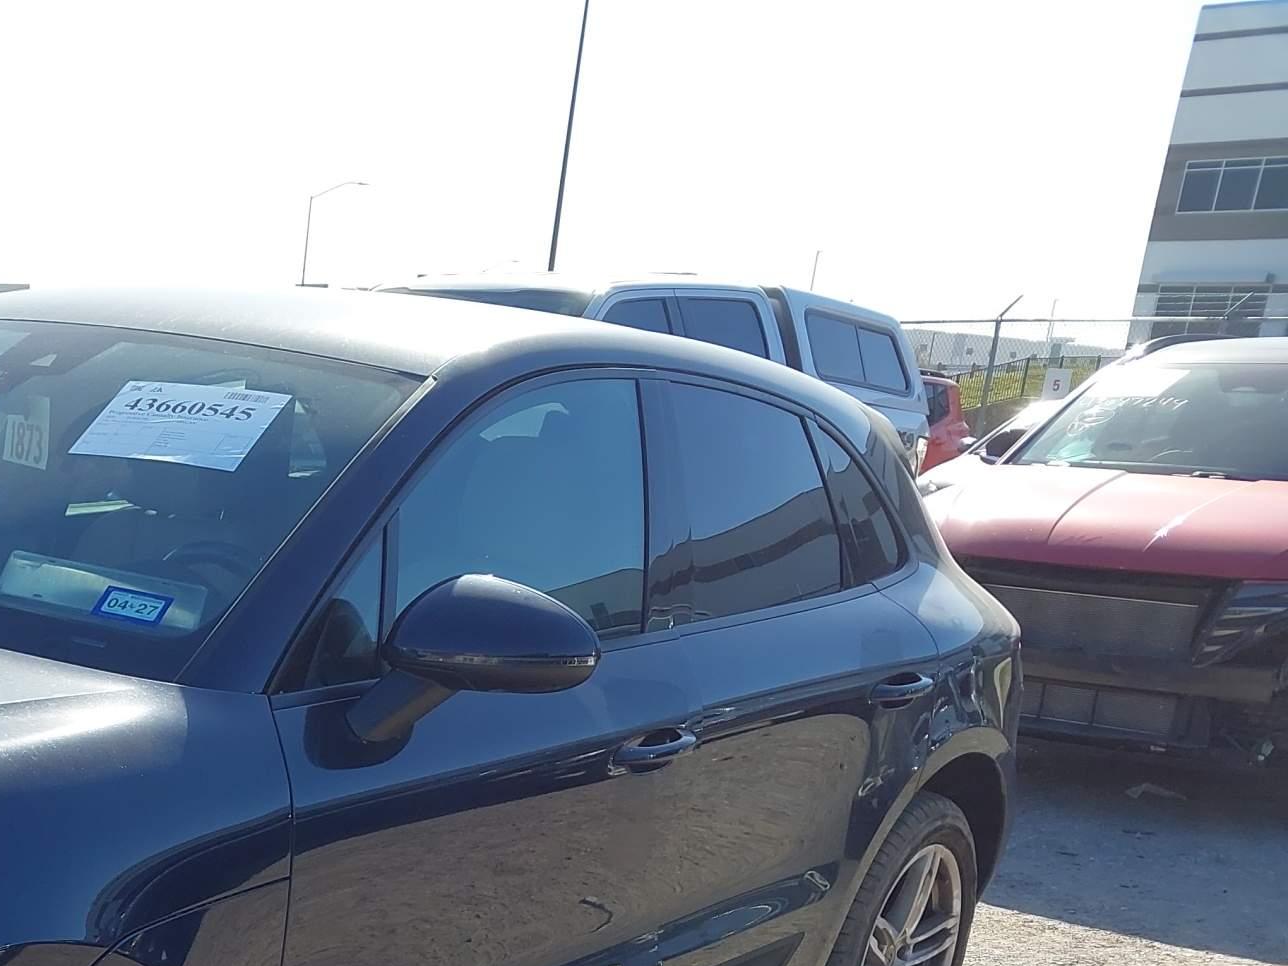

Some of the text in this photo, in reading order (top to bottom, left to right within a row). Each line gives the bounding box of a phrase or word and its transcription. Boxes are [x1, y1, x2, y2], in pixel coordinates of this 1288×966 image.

[1052, 379, 1061, 392] 5
[124, 396, 257, 421] 43660545
[9, 420, 43, 465] 1873
[107, 597, 129, 610] 04
[135, 603, 160, 616] 27
